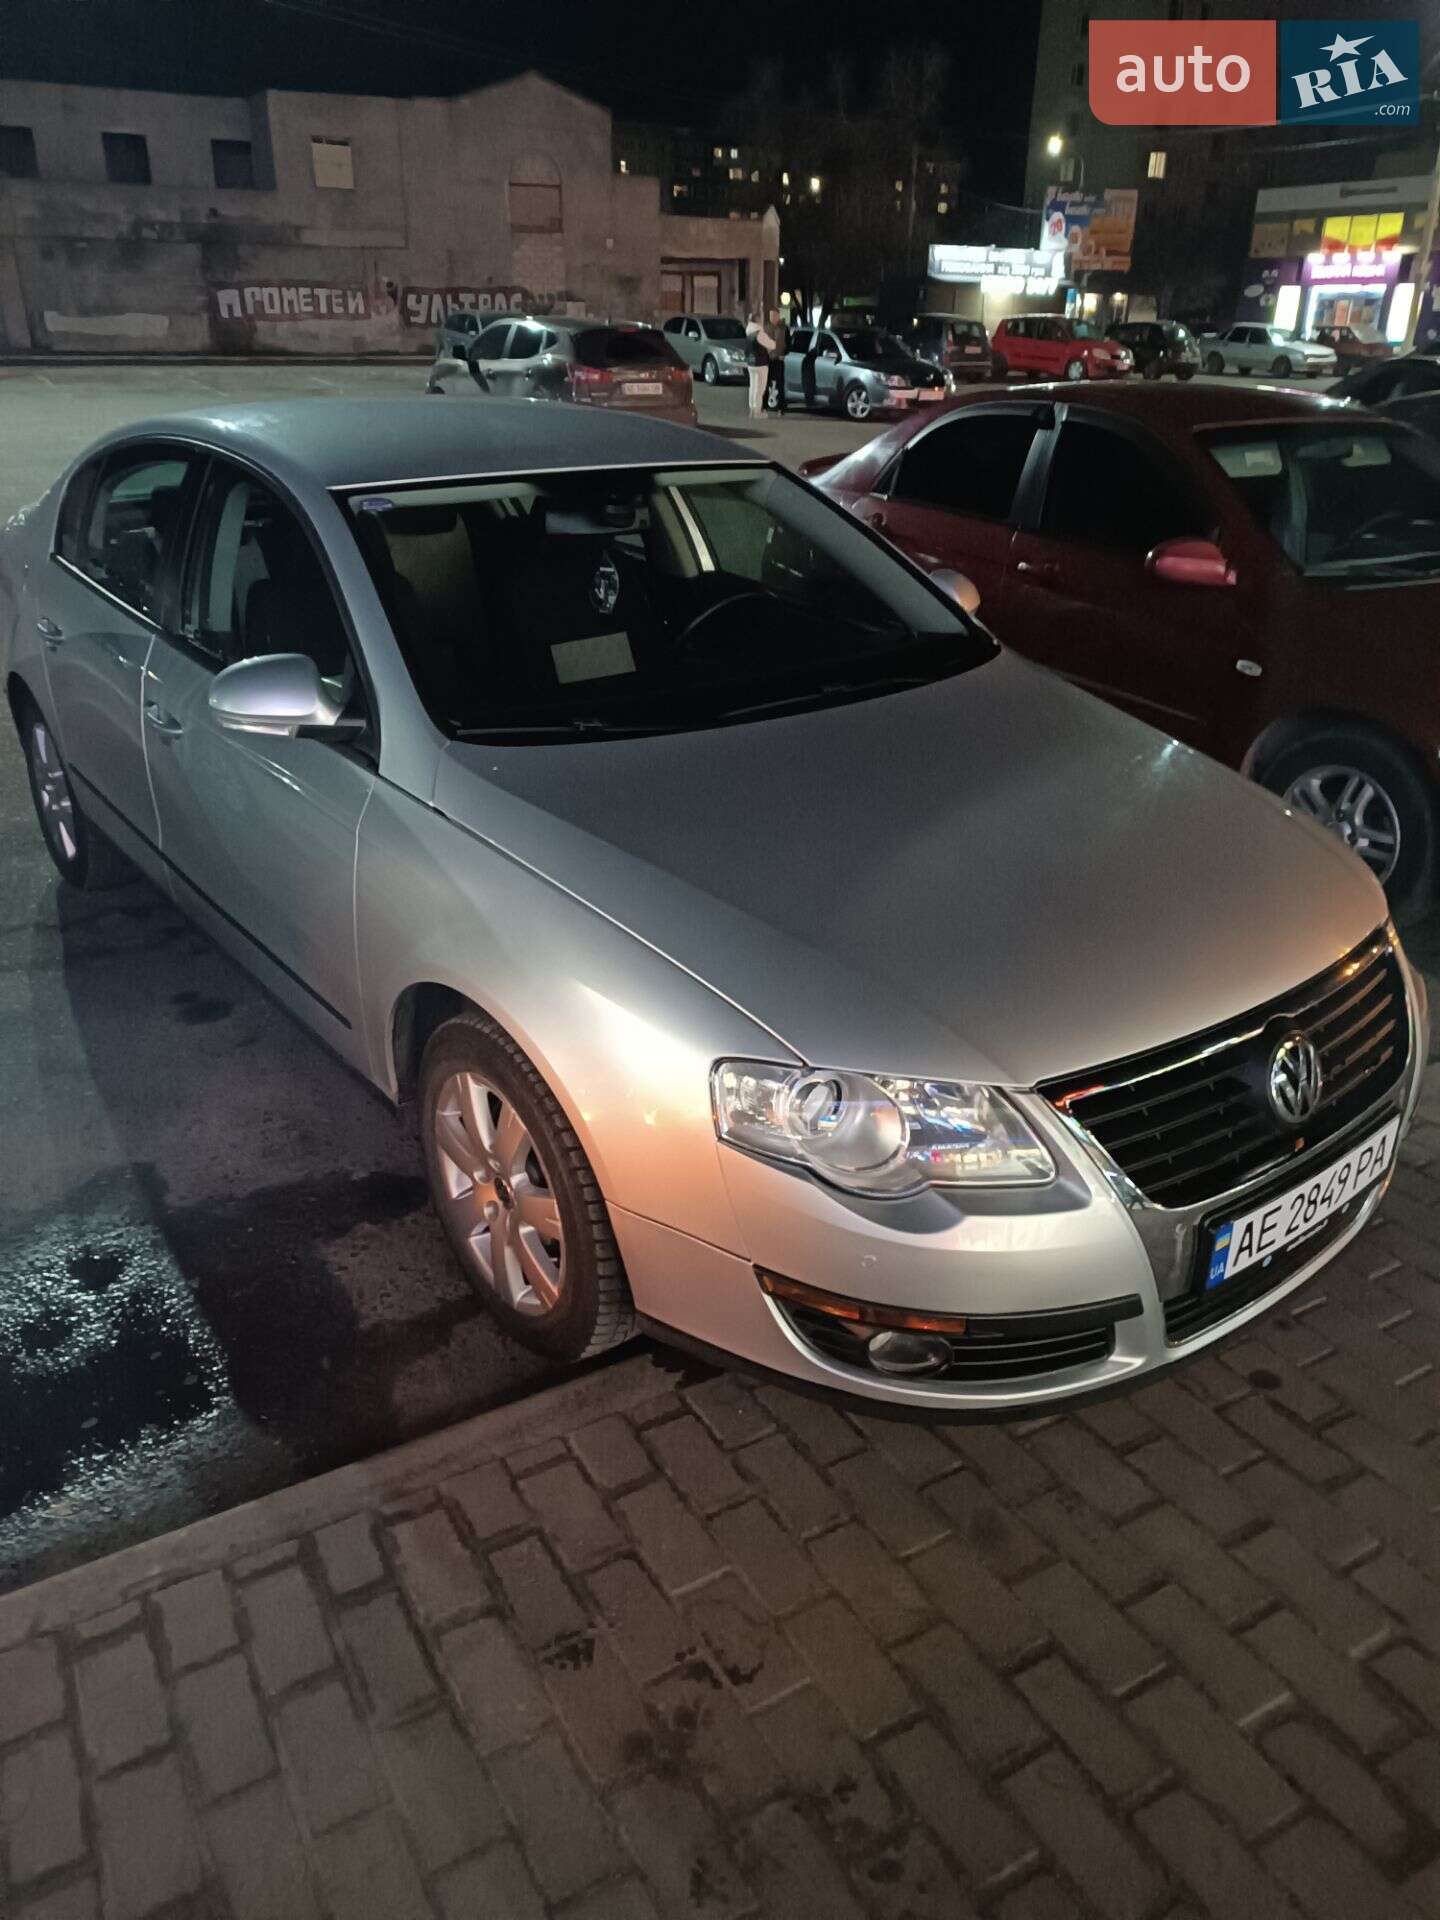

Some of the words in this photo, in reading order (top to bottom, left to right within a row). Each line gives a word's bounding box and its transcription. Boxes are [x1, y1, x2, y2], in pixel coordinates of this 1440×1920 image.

[1233, 1205, 1283, 1266] AE
[1284, 1163, 1351, 1236] 2849
[1353, 1136, 1387, 1189] PA
